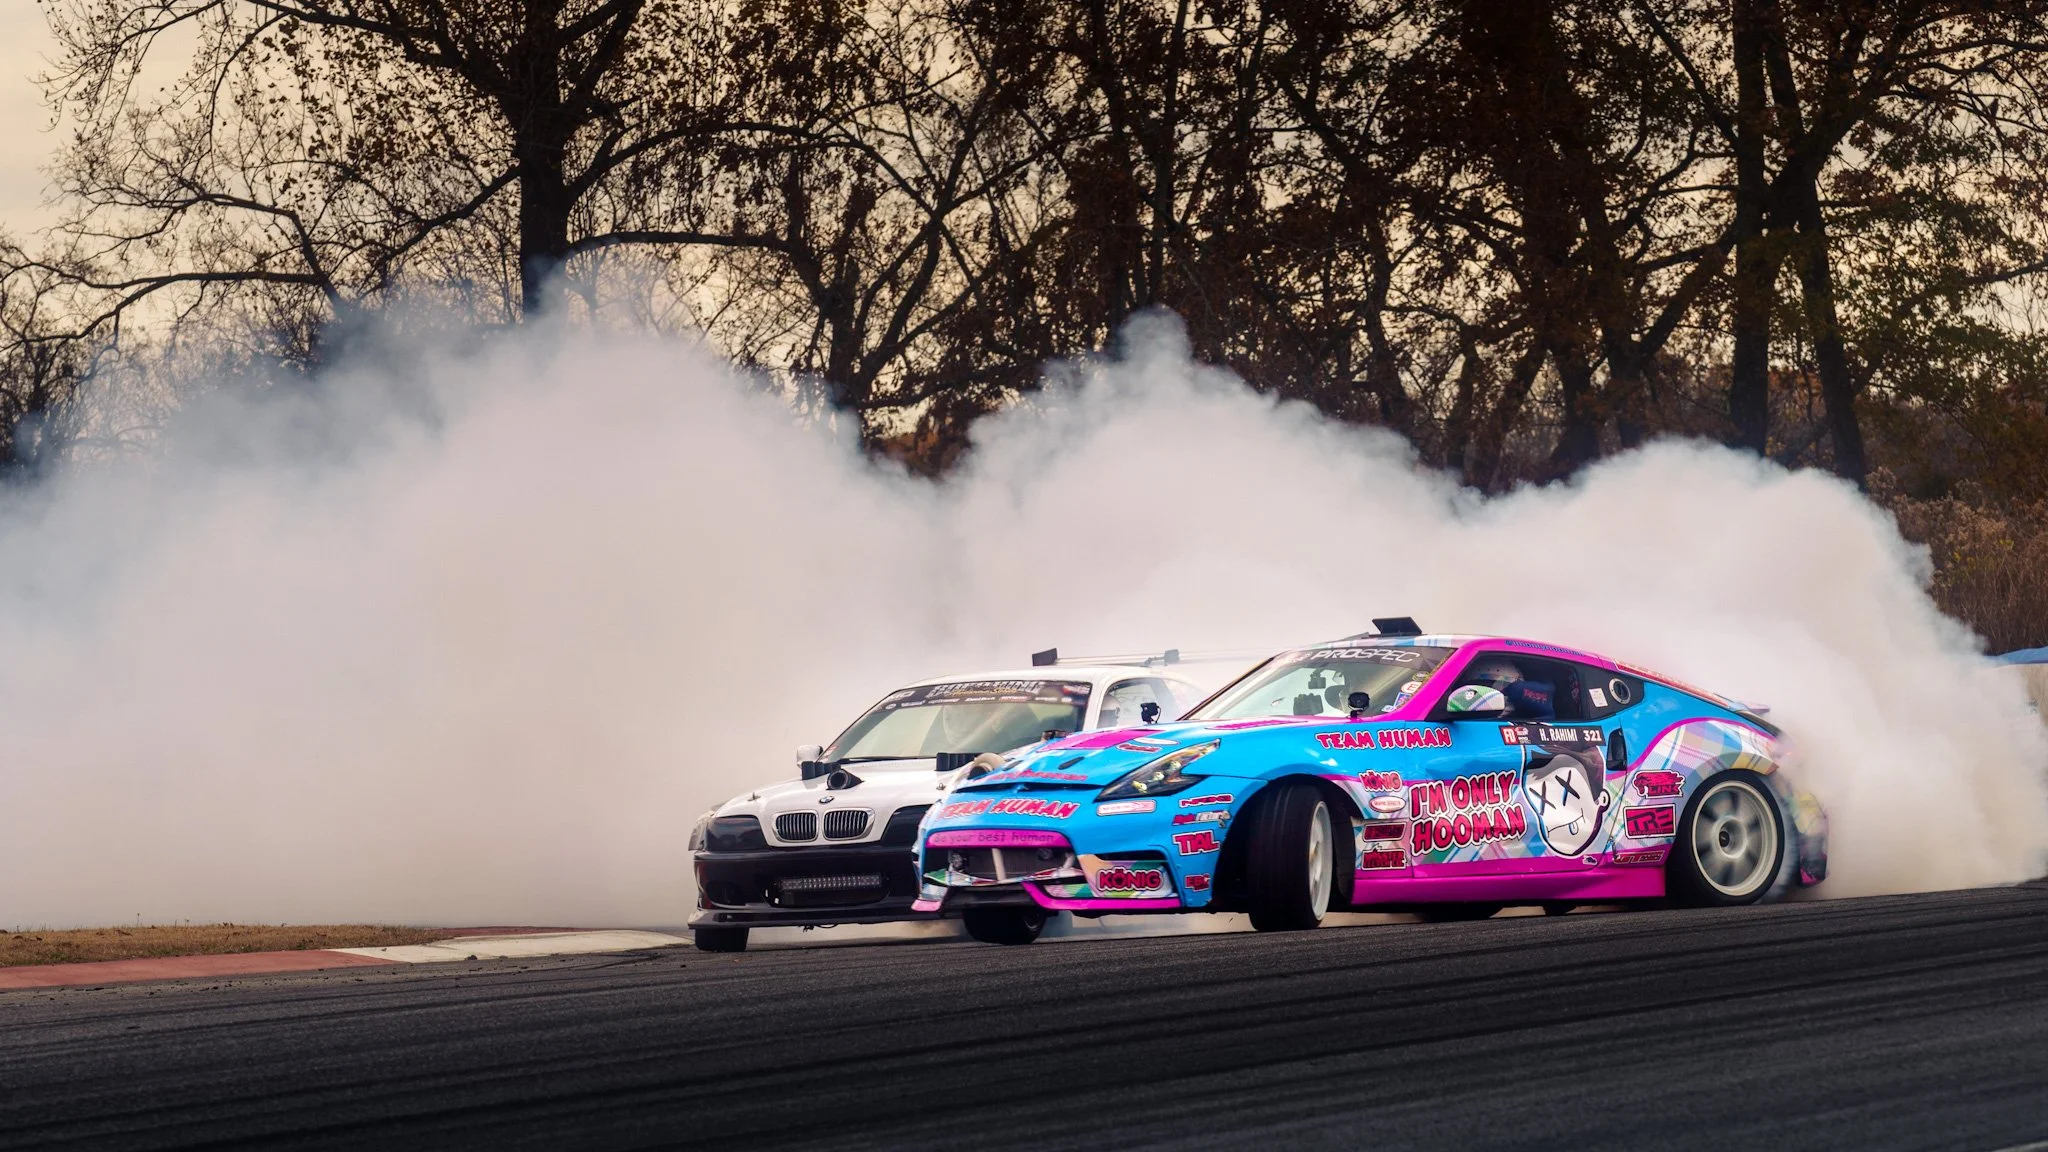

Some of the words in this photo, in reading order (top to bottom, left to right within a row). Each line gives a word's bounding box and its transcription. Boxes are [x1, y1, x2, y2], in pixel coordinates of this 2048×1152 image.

[1311, 649, 1420, 662] PROSPEC
[1316, 731, 1376, 749] TEAM
[1378, 728, 1452, 749] HUMAN
[1539, 728, 1550, 741] H.
[1549, 728, 1578, 742] RAHIMI
[1583, 729, 1603, 742] 321
[1411, 783, 1447, 818] I'M
[1451, 772, 1515, 809] ONLY
[938, 798, 994, 818] TEAM
[992, 798, 1080, 819] HUMAN
[950, 834, 974, 844] your
[977, 832, 1006, 842] best
[1011, 832, 1054, 842] human
[1412, 805, 1526, 853] HOOMAN
[1100, 868, 1162, 889] KÖNIG
